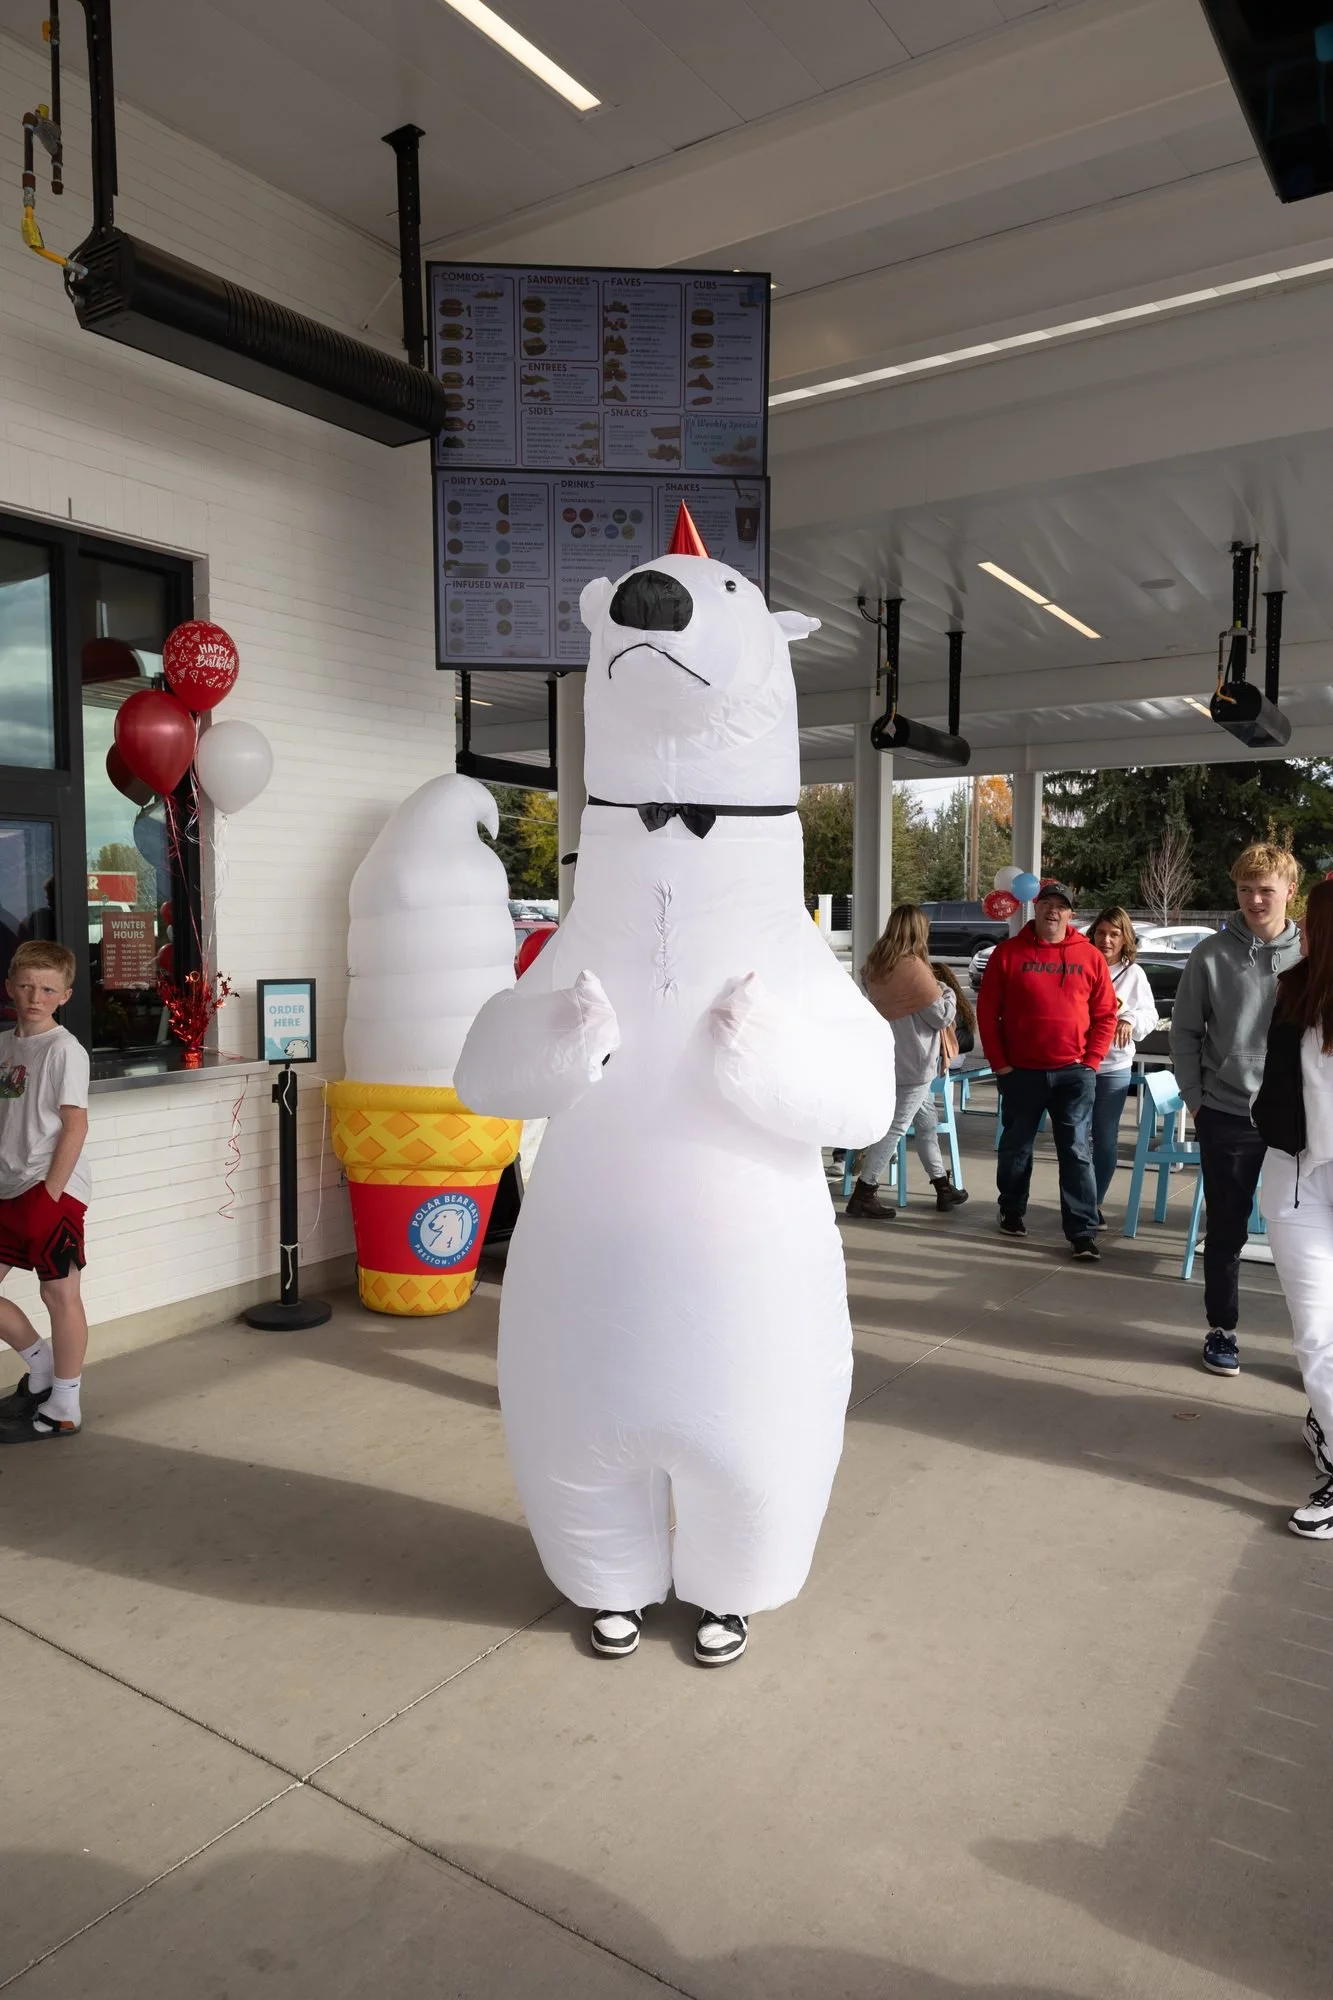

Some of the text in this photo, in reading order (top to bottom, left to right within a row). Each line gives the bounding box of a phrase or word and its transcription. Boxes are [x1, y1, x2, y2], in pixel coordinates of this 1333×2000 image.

[441, 272, 485, 282] COMBOS
[527, 275, 590, 285] SANDWICHES
[611, 277, 641, 287] FAVES
[693, 280, 717, 290] CUBS
[466, 305, 473, 318] 1
[465, 327, 473, 340] 2
[466, 351, 474, 363] 3
[528, 363, 568, 372] ENTREES
[466, 375, 475, 388] 4
[466, 399, 475, 411] 5
[528, 407, 554, 416] SIDES
[610, 408, 648, 418] SNACKS
[467, 419, 475, 432] 6
[697, 417, 728, 430] Weekly
[451, 477, 507, 486] DIRTY SODA
[561, 480, 595, 489] DRINKS
[665, 482, 700, 492] SHAKES
[452, 580, 525, 590] INFUSED WATER
[199, 643, 230, 657] HAPPY
[195, 654, 235, 675] Birthday
[111, 921, 146, 929] WINTER
[113, 930, 145, 939] HOURS
[1022, 961, 1083, 975] DUCATI
[269, 1005, 305, 1014] ORDER
[274, 1018, 301, 1027] HERE
[412, 1195, 479, 1227] POLAR BEAR EATS
[453, 1239, 473, 1262] IDAHO
